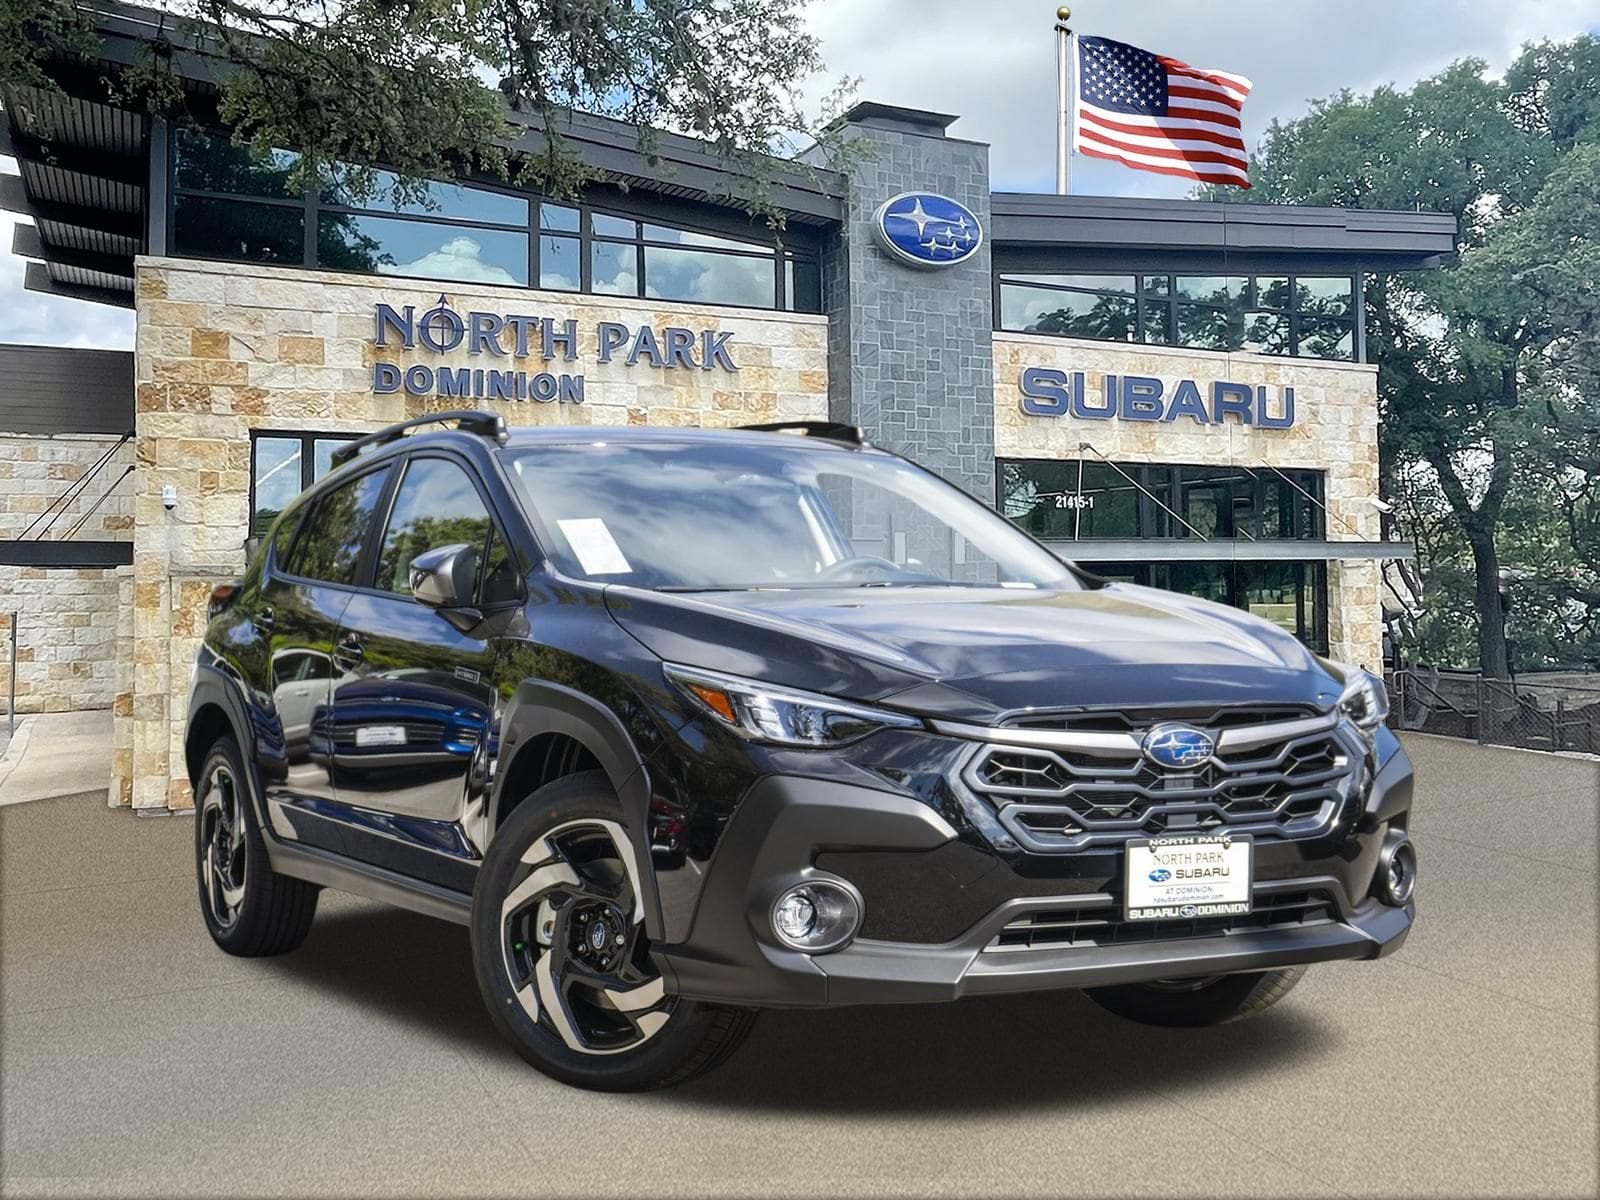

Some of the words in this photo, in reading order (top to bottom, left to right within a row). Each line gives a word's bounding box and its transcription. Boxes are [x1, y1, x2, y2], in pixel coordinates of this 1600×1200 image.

[374, 294, 579, 361] NORTH
[597, 320, 742, 373] PARK
[373, 362, 585, 405] DOMINION
[1018, 367, 1295, 430] SUBARU
[1055, 495, 1094, 509] 21415-1
[1149, 838, 1194, 847] NORTH
[1198, 835, 1232, 845] PARK
[1153, 853, 1192, 866] NORTH
[1196, 851, 1225, 864] PARK
[1175, 867, 1230, 879] SUBARU
[1176, 886, 1213, 895] DOMINION
[1129, 907, 1179, 919] SUBARU
[1198, 903, 1249, 915] DOMINION
